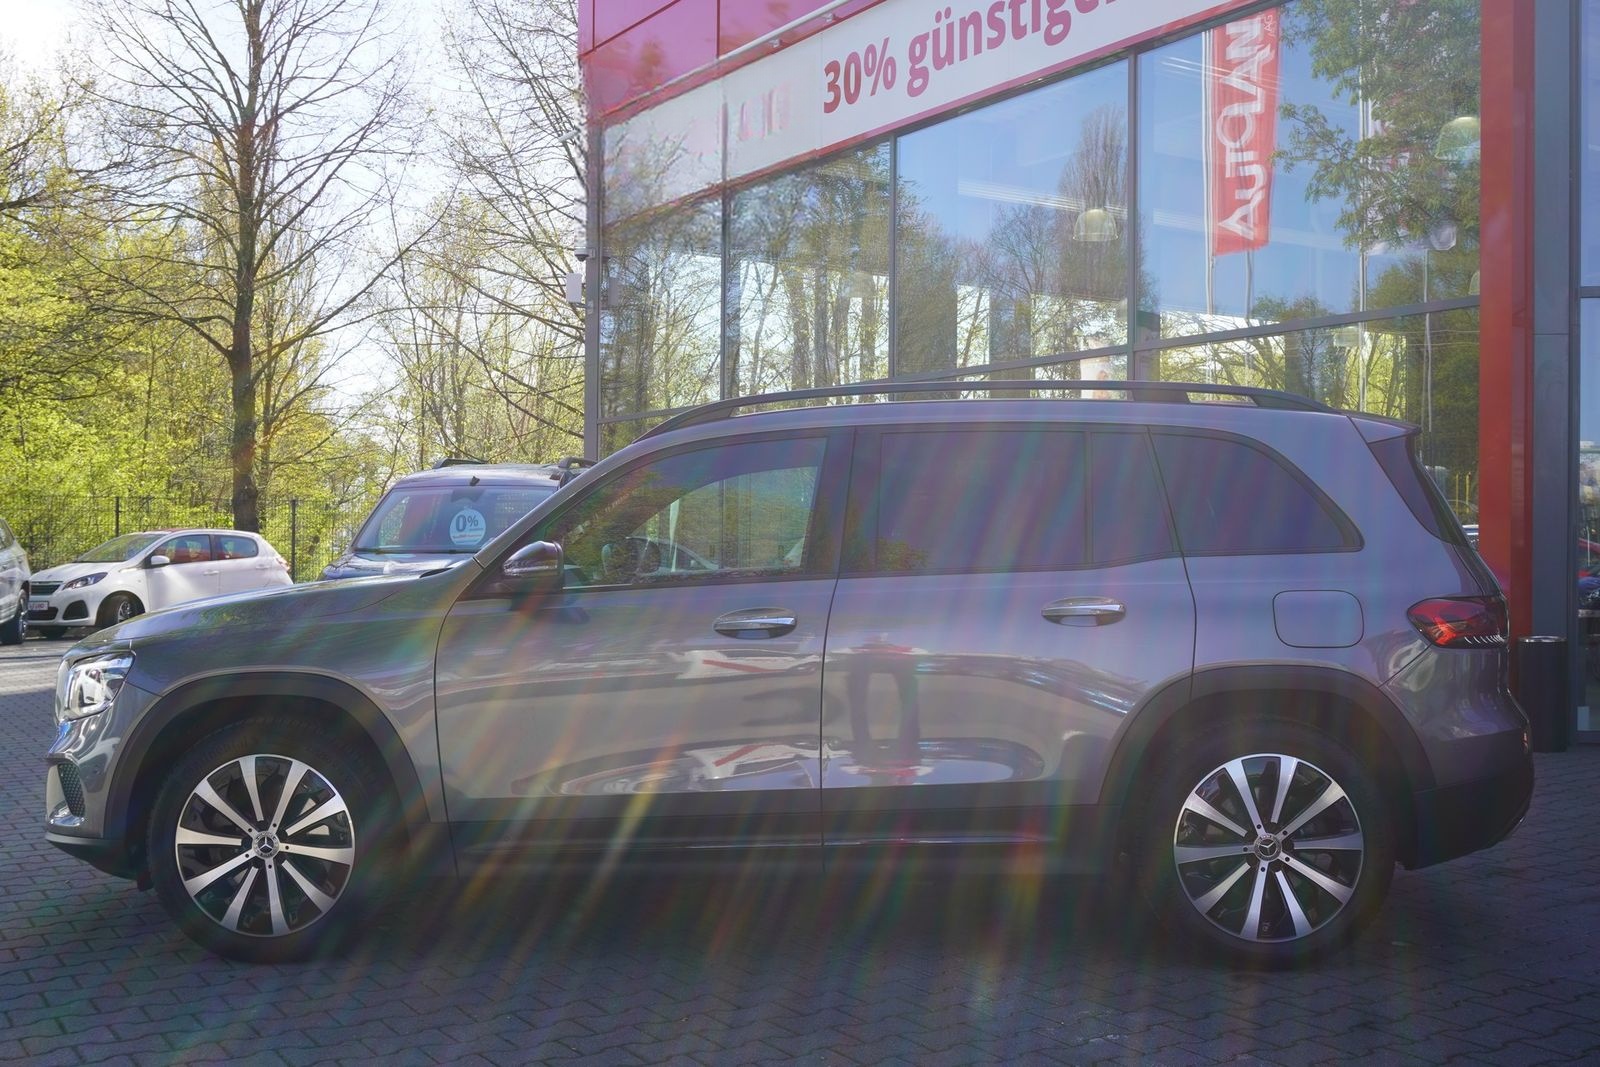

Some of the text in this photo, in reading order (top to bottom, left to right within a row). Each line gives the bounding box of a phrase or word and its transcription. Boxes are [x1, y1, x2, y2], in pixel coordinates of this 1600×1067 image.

[824, 0, 1117, 113] 30% günstig
[455, 514, 479, 532] 0%
